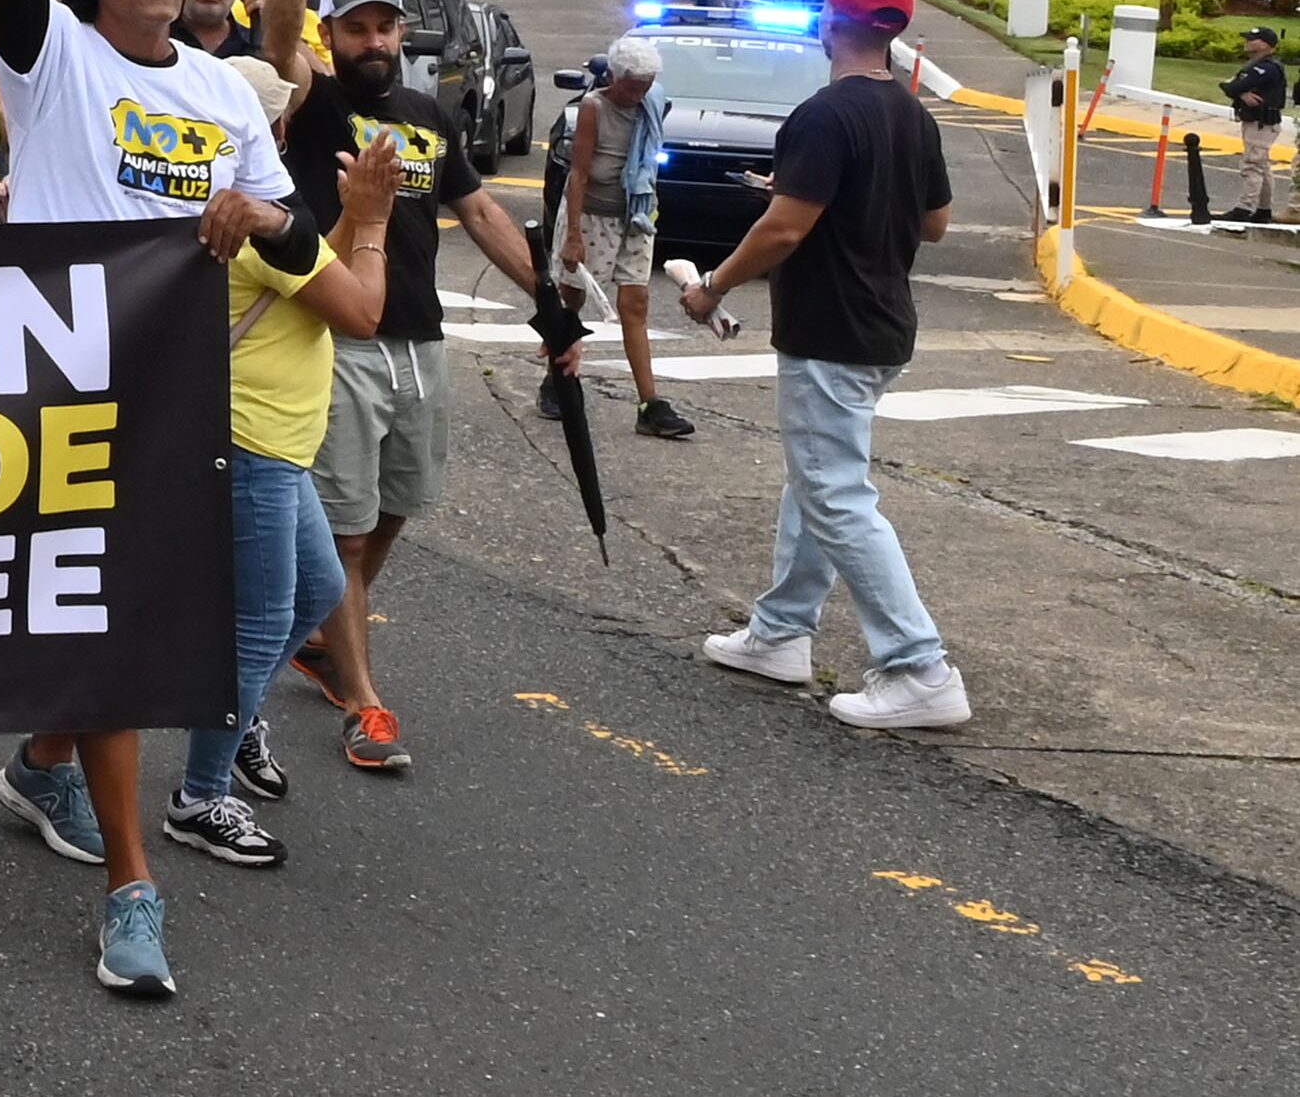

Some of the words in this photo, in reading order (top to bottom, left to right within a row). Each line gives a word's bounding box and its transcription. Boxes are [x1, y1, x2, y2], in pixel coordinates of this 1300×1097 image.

[648, 35, 804, 54] POLICIA
[119, 166, 136, 185] A
[141, 173, 166, 194] LA
[168, 179, 210, 199] LUZ
